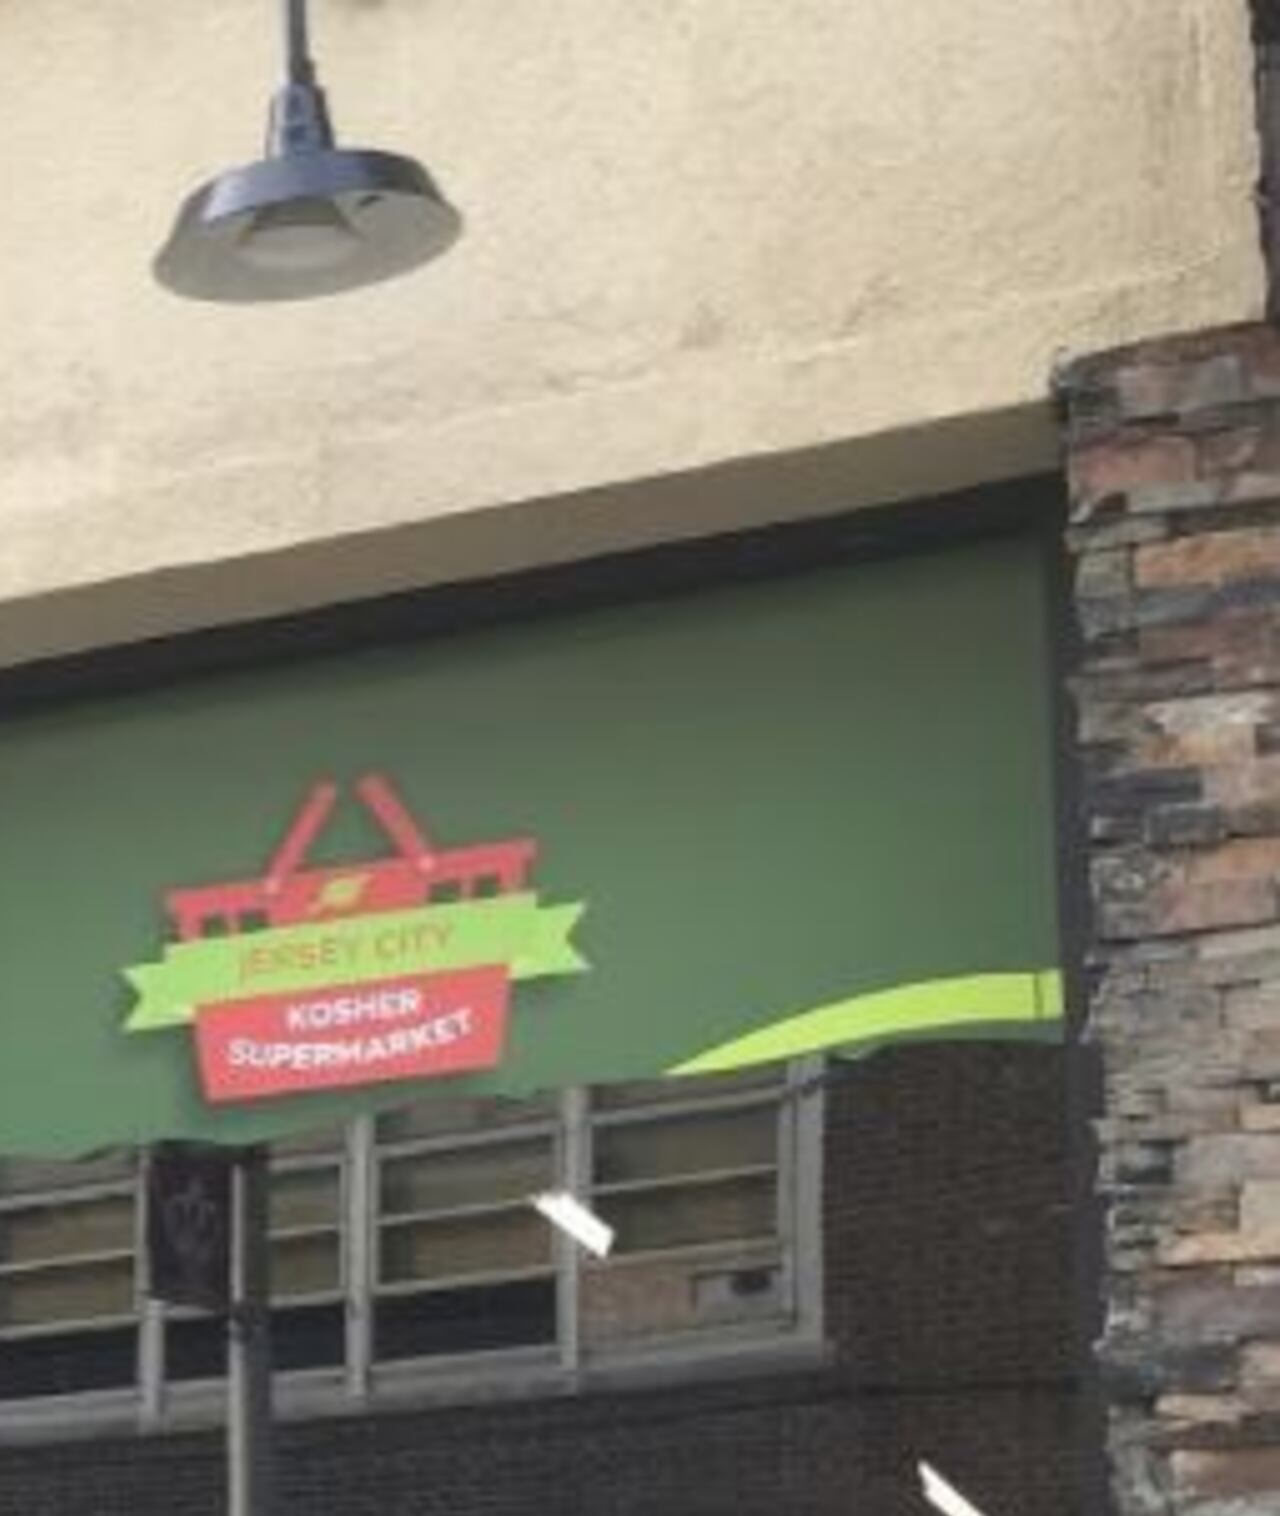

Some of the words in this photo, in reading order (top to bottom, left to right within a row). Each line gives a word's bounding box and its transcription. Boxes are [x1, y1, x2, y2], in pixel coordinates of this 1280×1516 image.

[239, 933, 360, 983] JERSEY
[374, 922, 456, 961] CITY
[228, 1007, 472, 1070] SUPERMARKET
[287, 988, 422, 1029] KOSHER
